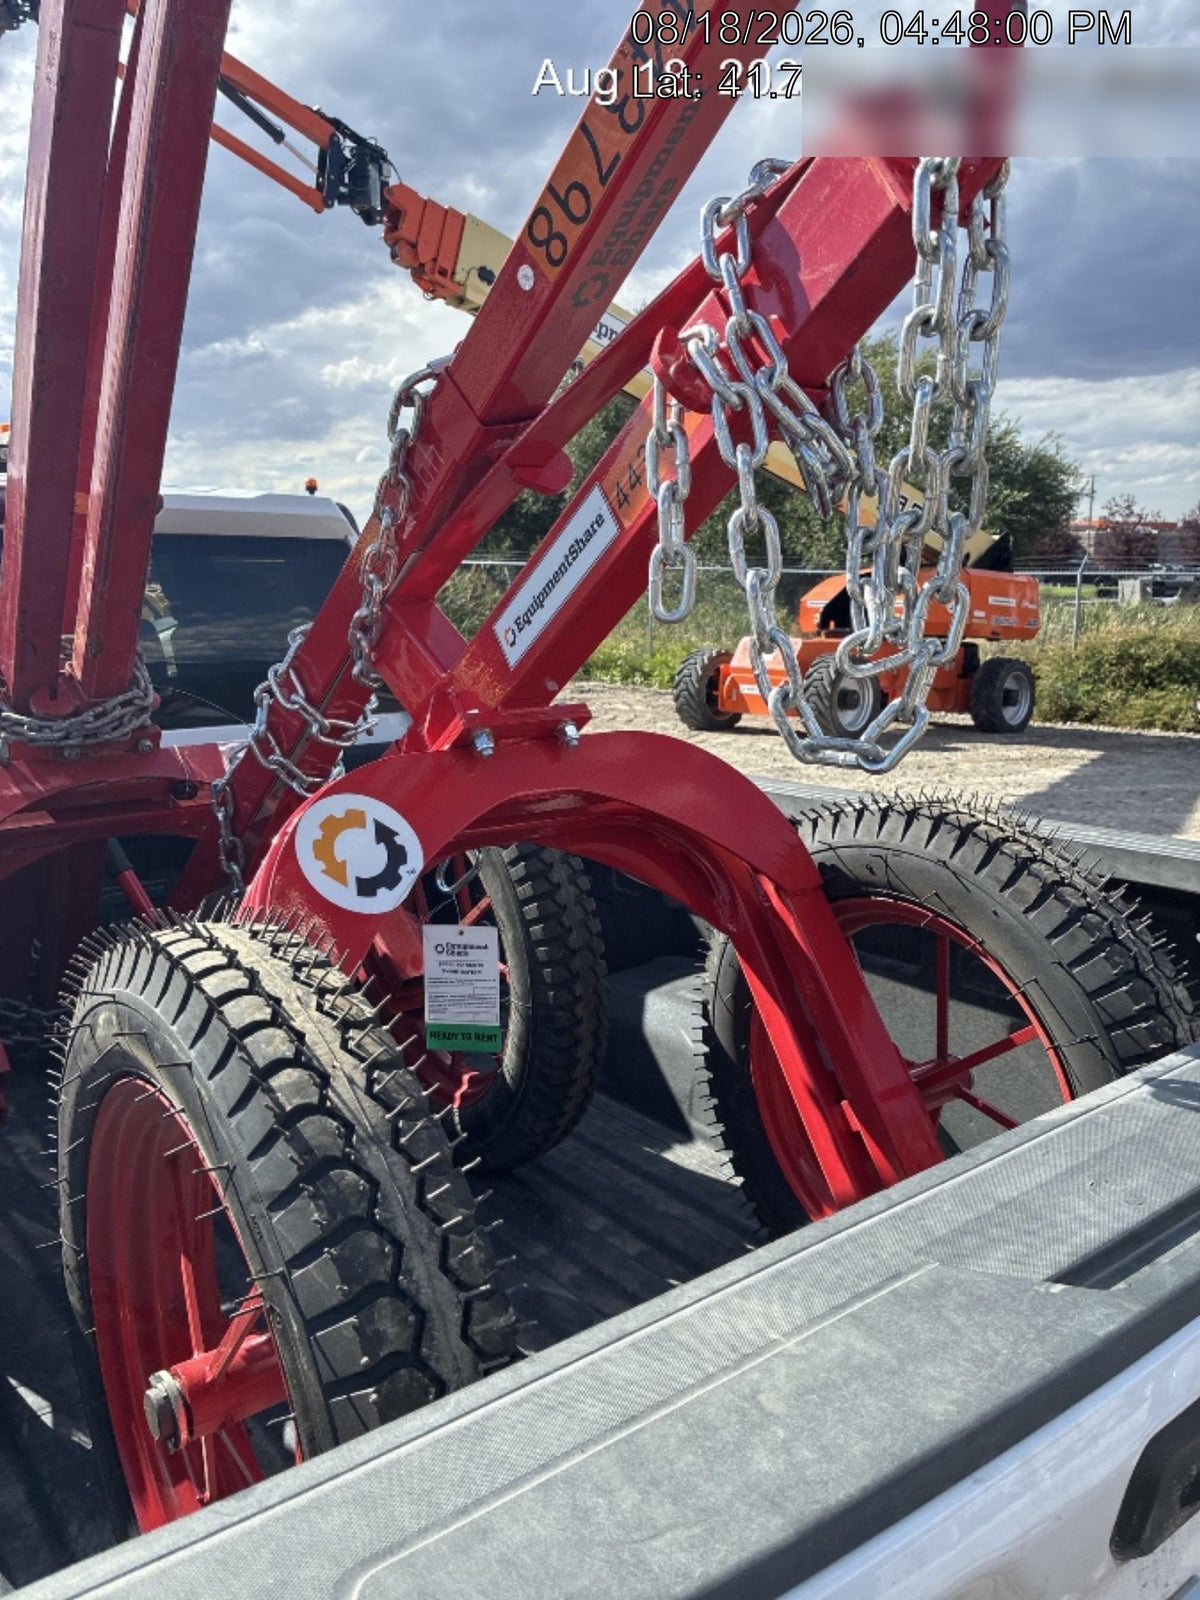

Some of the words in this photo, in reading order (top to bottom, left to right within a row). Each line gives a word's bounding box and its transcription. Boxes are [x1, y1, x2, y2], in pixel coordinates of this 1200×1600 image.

[610, 176, 678, 267] Share
[515, 512, 605, 634] EquipmentShare
[430, 1031, 458, 1040] READY
[461, 1031, 472, 1041] TO
[474, 1033, 498, 1042] RENT
